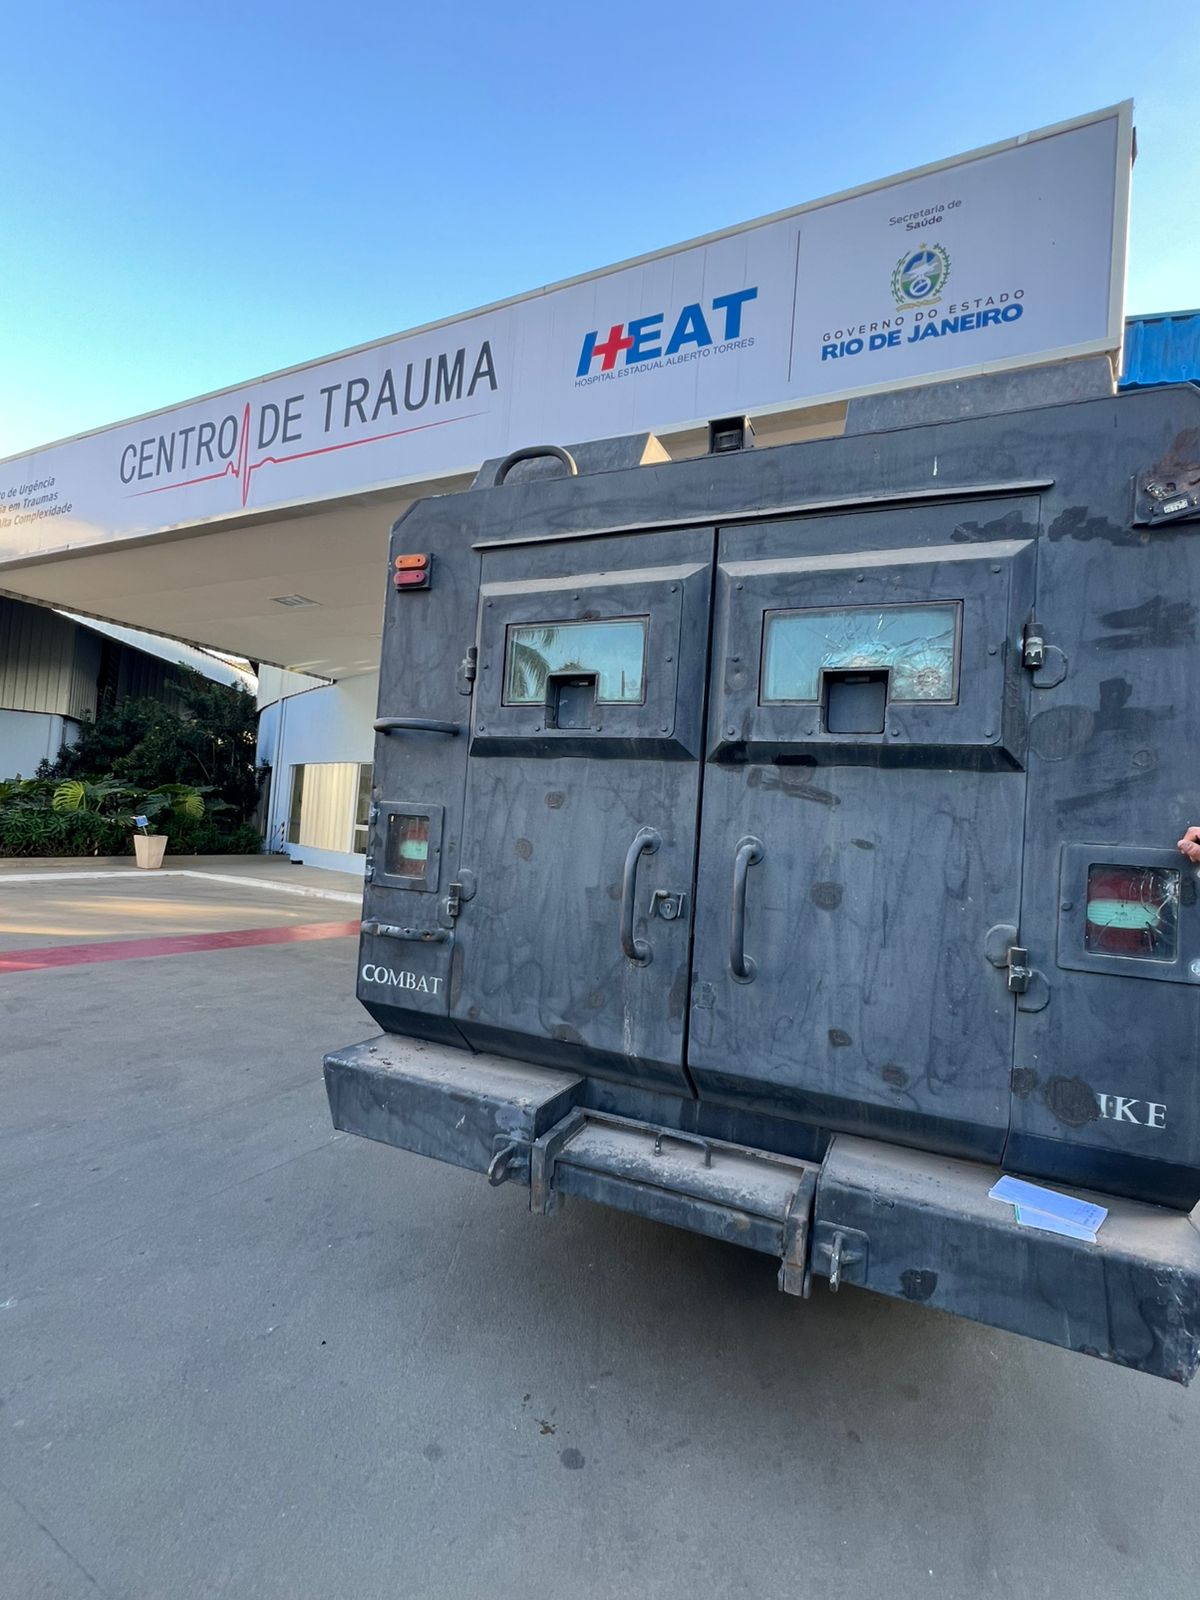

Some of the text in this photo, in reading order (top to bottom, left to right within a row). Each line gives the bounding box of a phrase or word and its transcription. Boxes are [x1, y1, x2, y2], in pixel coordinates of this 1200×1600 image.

[889, 199, 962, 226] Secretaria de
[905, 215, 943, 232] Saúde
[823, 289, 1025, 342] GOVERNO DO ESTADO
[576, 286, 758, 377] HEAT
[821, 303, 1024, 361] RIO DE JANEIRO
[574, 337, 755, 388] HOSPITAL ESTADUAL ALBERTO TORRES
[120, 340, 498, 484] CENTRO DE TRAUMA
[7, 487, 18, 498] de
[19, 476, 55, 495] Urgência
[8, 502, 20, 512] em
[23, 492, 59, 508] Traumas
[14, 502, 73, 525] Complexidade
[361, 963, 443, 994] COMBAT
